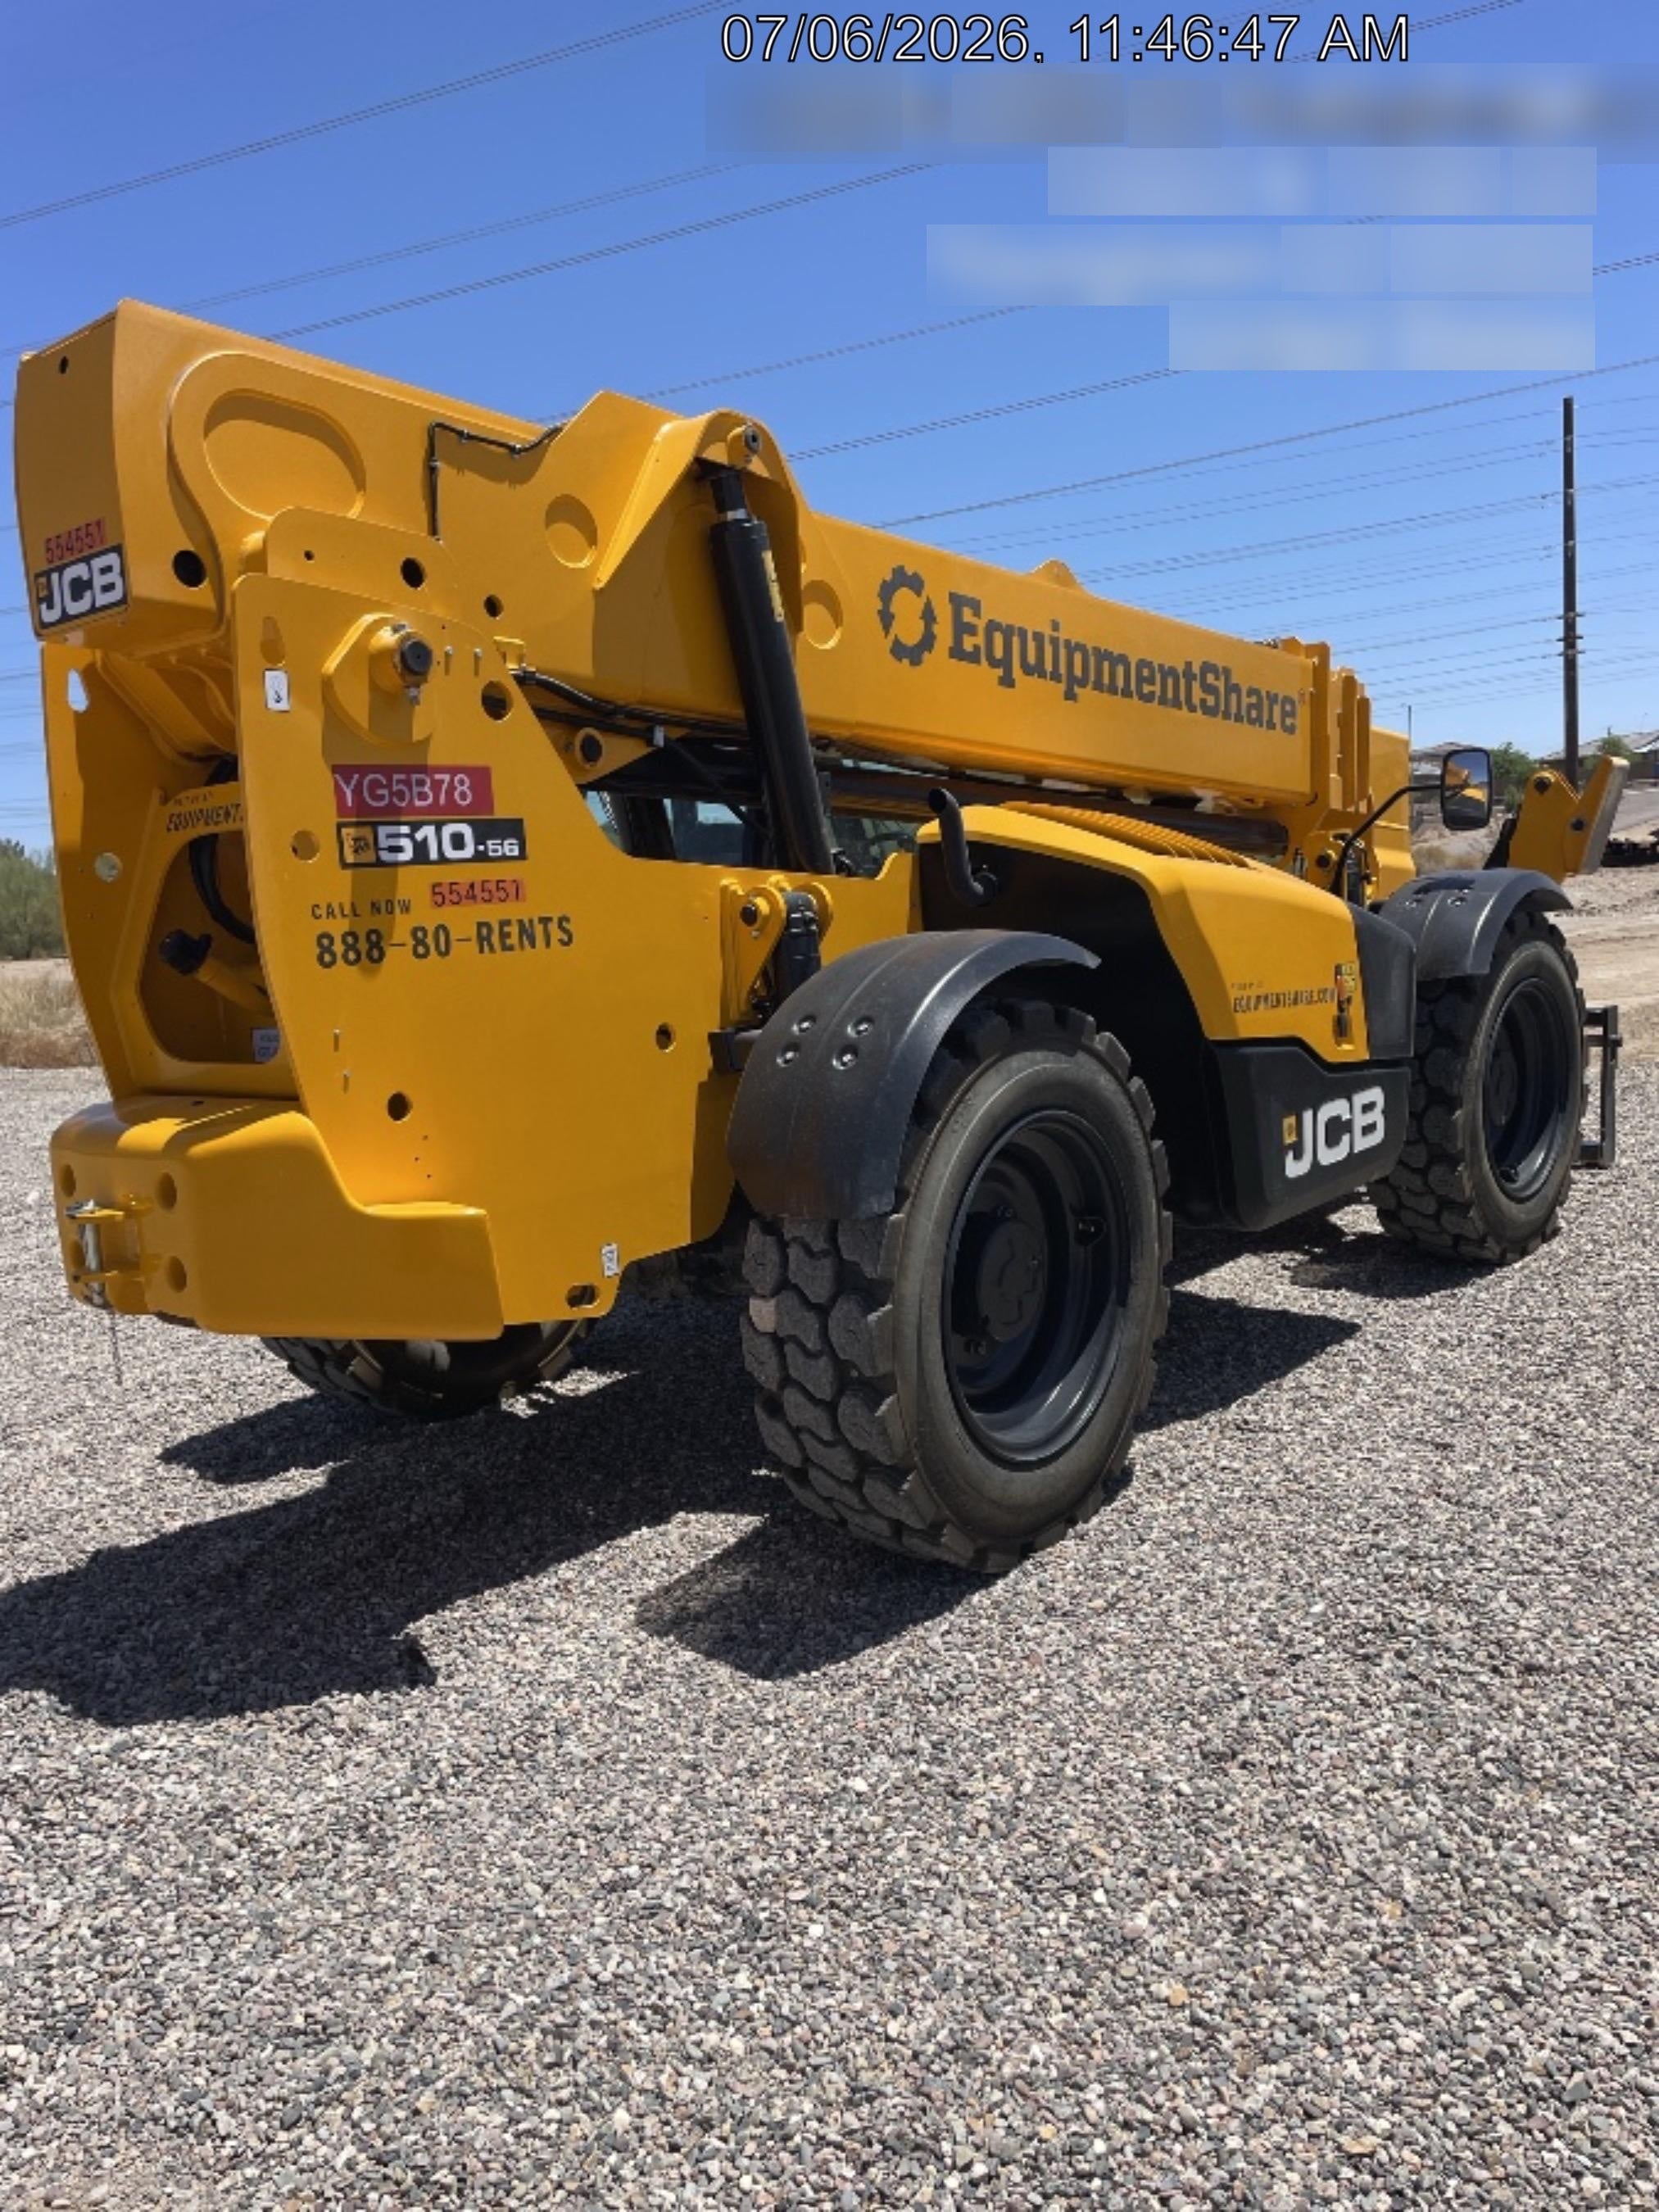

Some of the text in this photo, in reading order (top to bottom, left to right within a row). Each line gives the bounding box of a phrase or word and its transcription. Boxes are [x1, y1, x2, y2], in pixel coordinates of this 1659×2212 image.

[45, 518, 105, 564] 554551
[40, 552, 124, 623] JCB
[948, 591, 1297, 735] EquipmentShare
[334, 773, 473, 808] YG5B78
[166, 803, 243, 832] EQUIPMENT
[310, 899, 410, 920] CALL NOW
[432, 879, 521, 908] 554551
[316, 913, 574, 969] 888-80-RENTS
[1284, 1086, 1385, 1178] JCB
